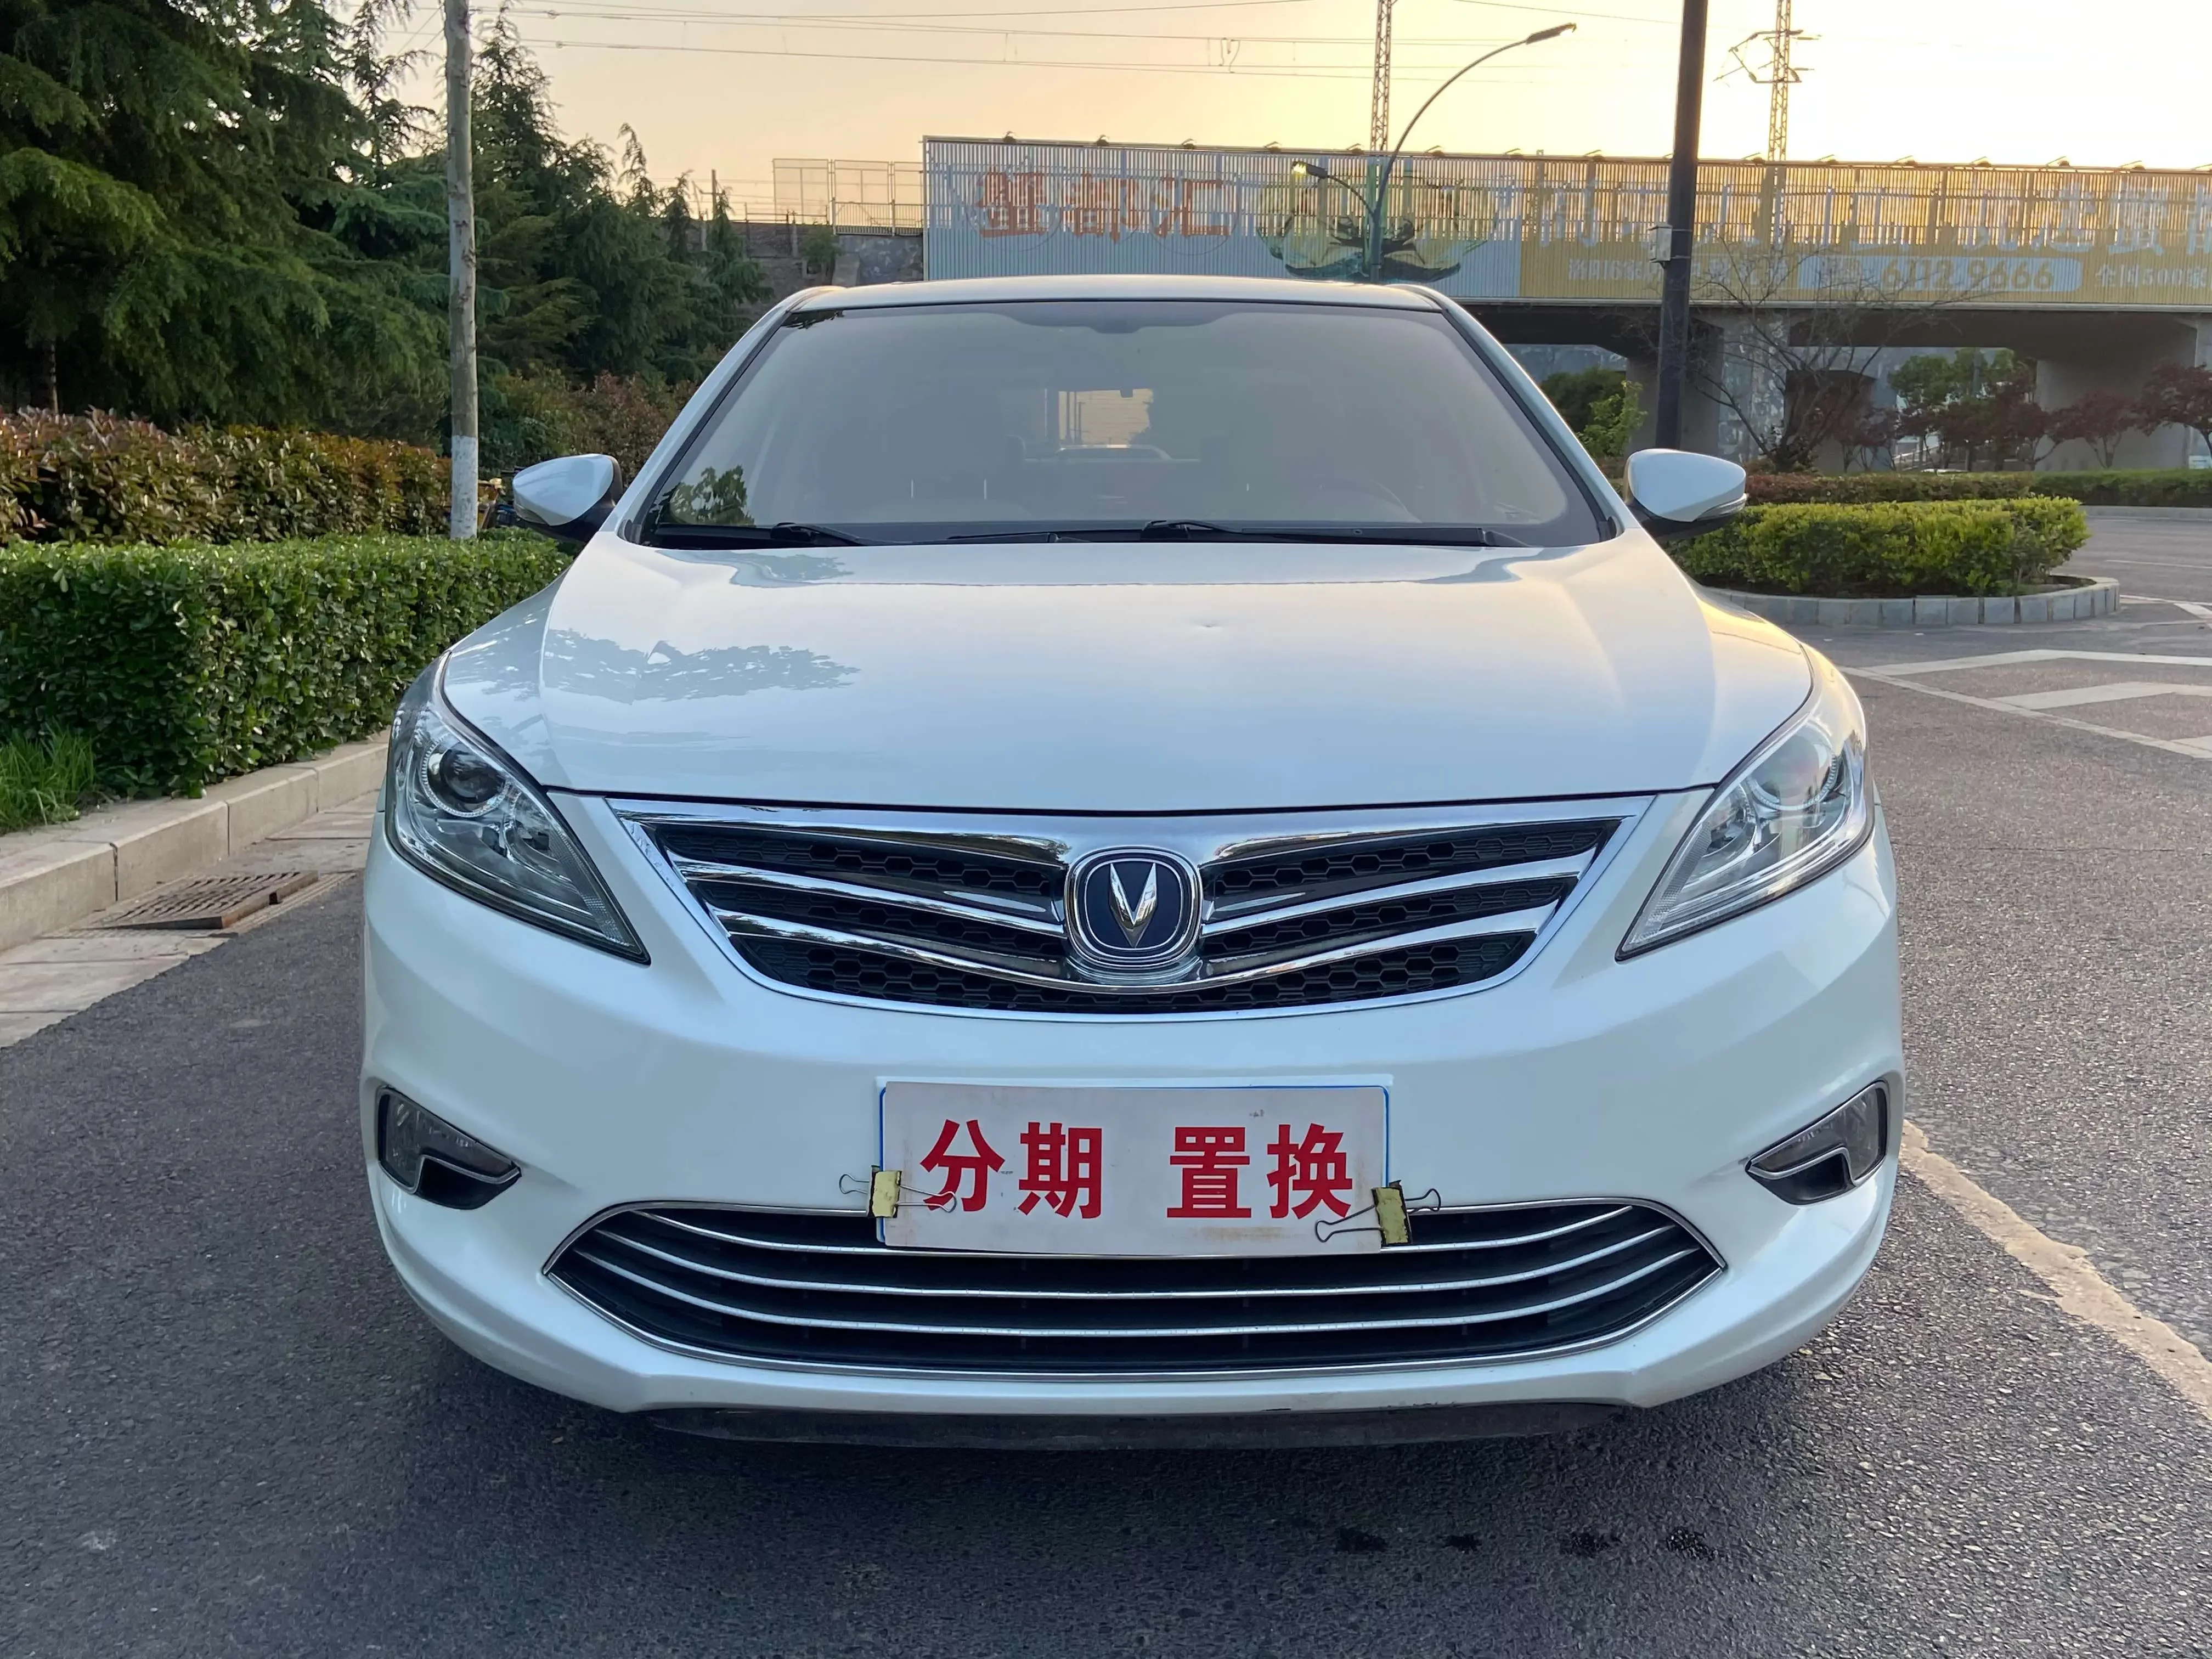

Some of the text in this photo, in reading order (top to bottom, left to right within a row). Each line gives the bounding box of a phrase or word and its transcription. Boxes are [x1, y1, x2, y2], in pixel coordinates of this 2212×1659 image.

[1966, 260, 2055, 290] 9666
[920, 1119, 1353, 1218] 分期 置换
